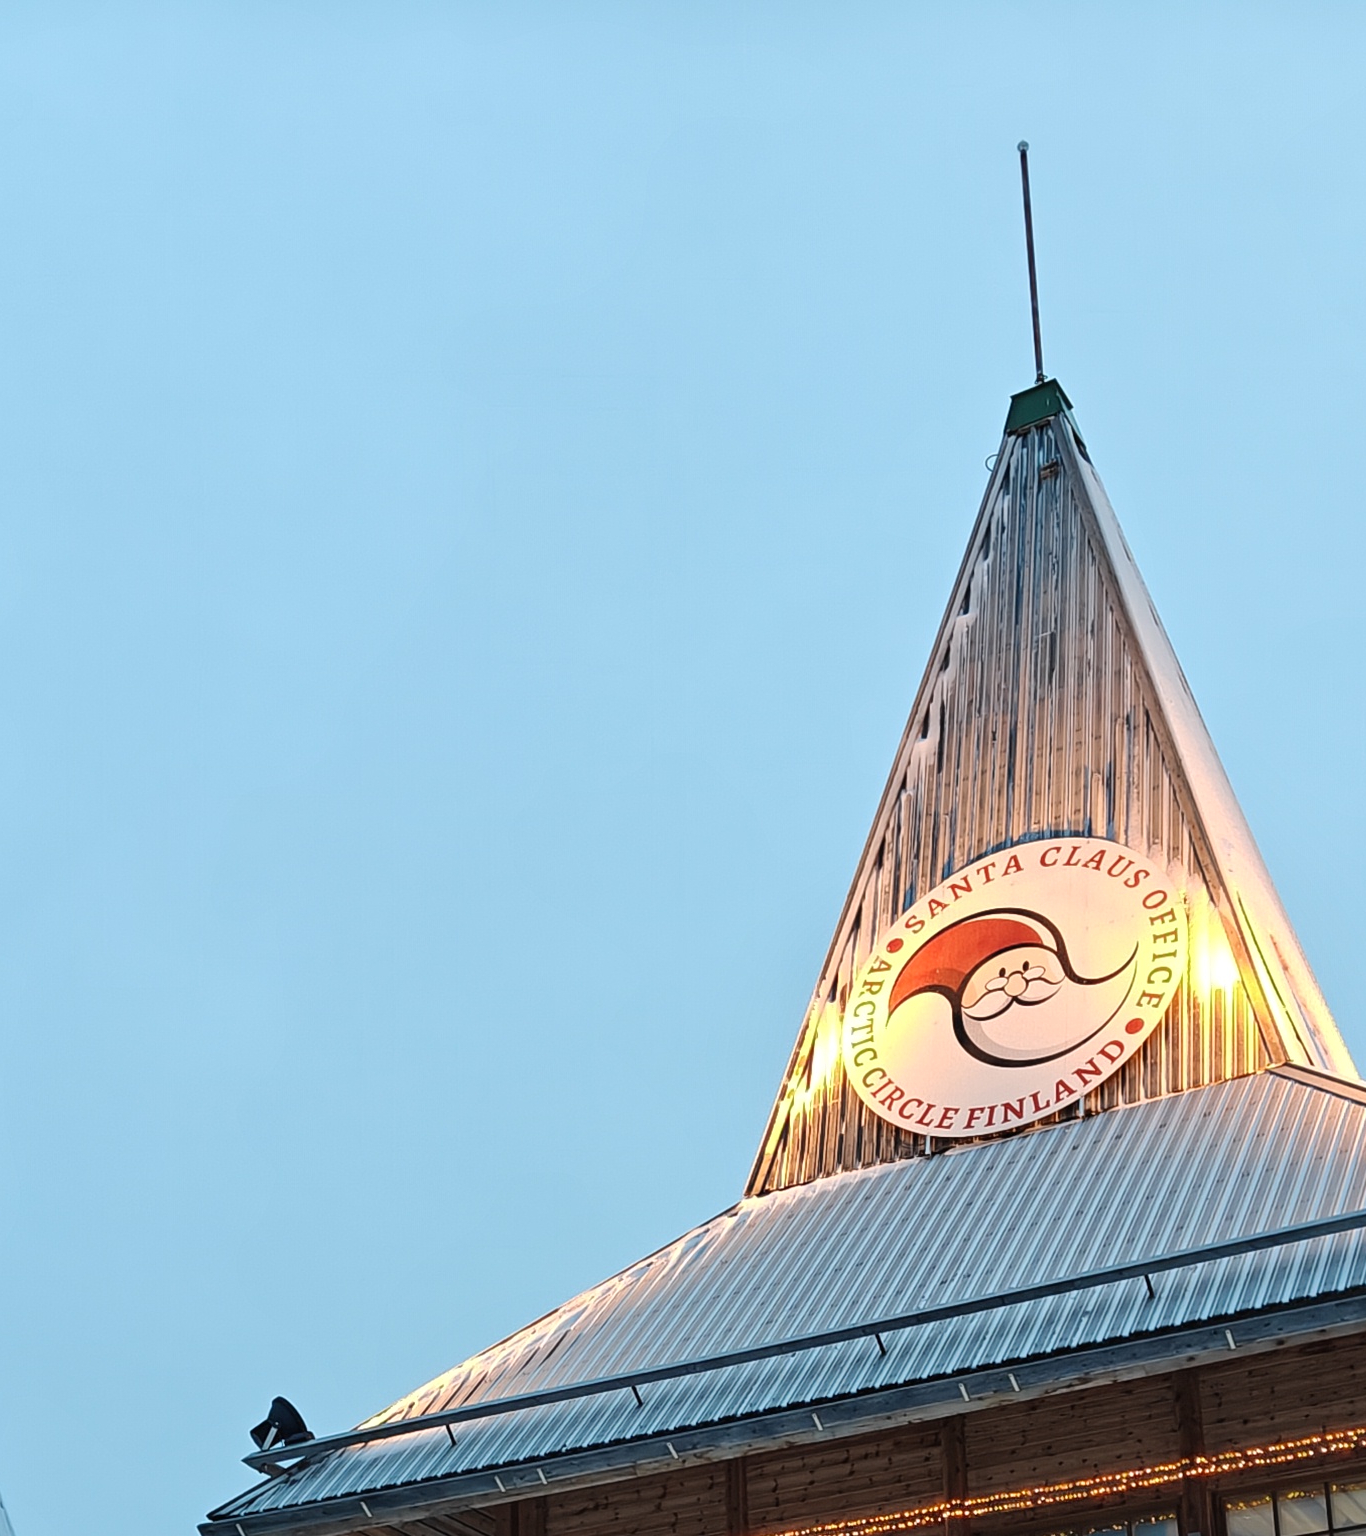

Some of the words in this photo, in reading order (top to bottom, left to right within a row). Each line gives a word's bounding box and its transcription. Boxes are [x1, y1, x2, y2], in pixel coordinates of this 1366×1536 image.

[904, 854, 1024, 934] SANTA
[1039, 846, 1150, 889] CLAUS
[1135, 889, 1179, 1010] OFFICE
[850, 955, 893, 1068] ARCTIC
[862, 1067, 959, 1130] CIRCLE
[964, 1039, 1125, 1130] FINLAND
